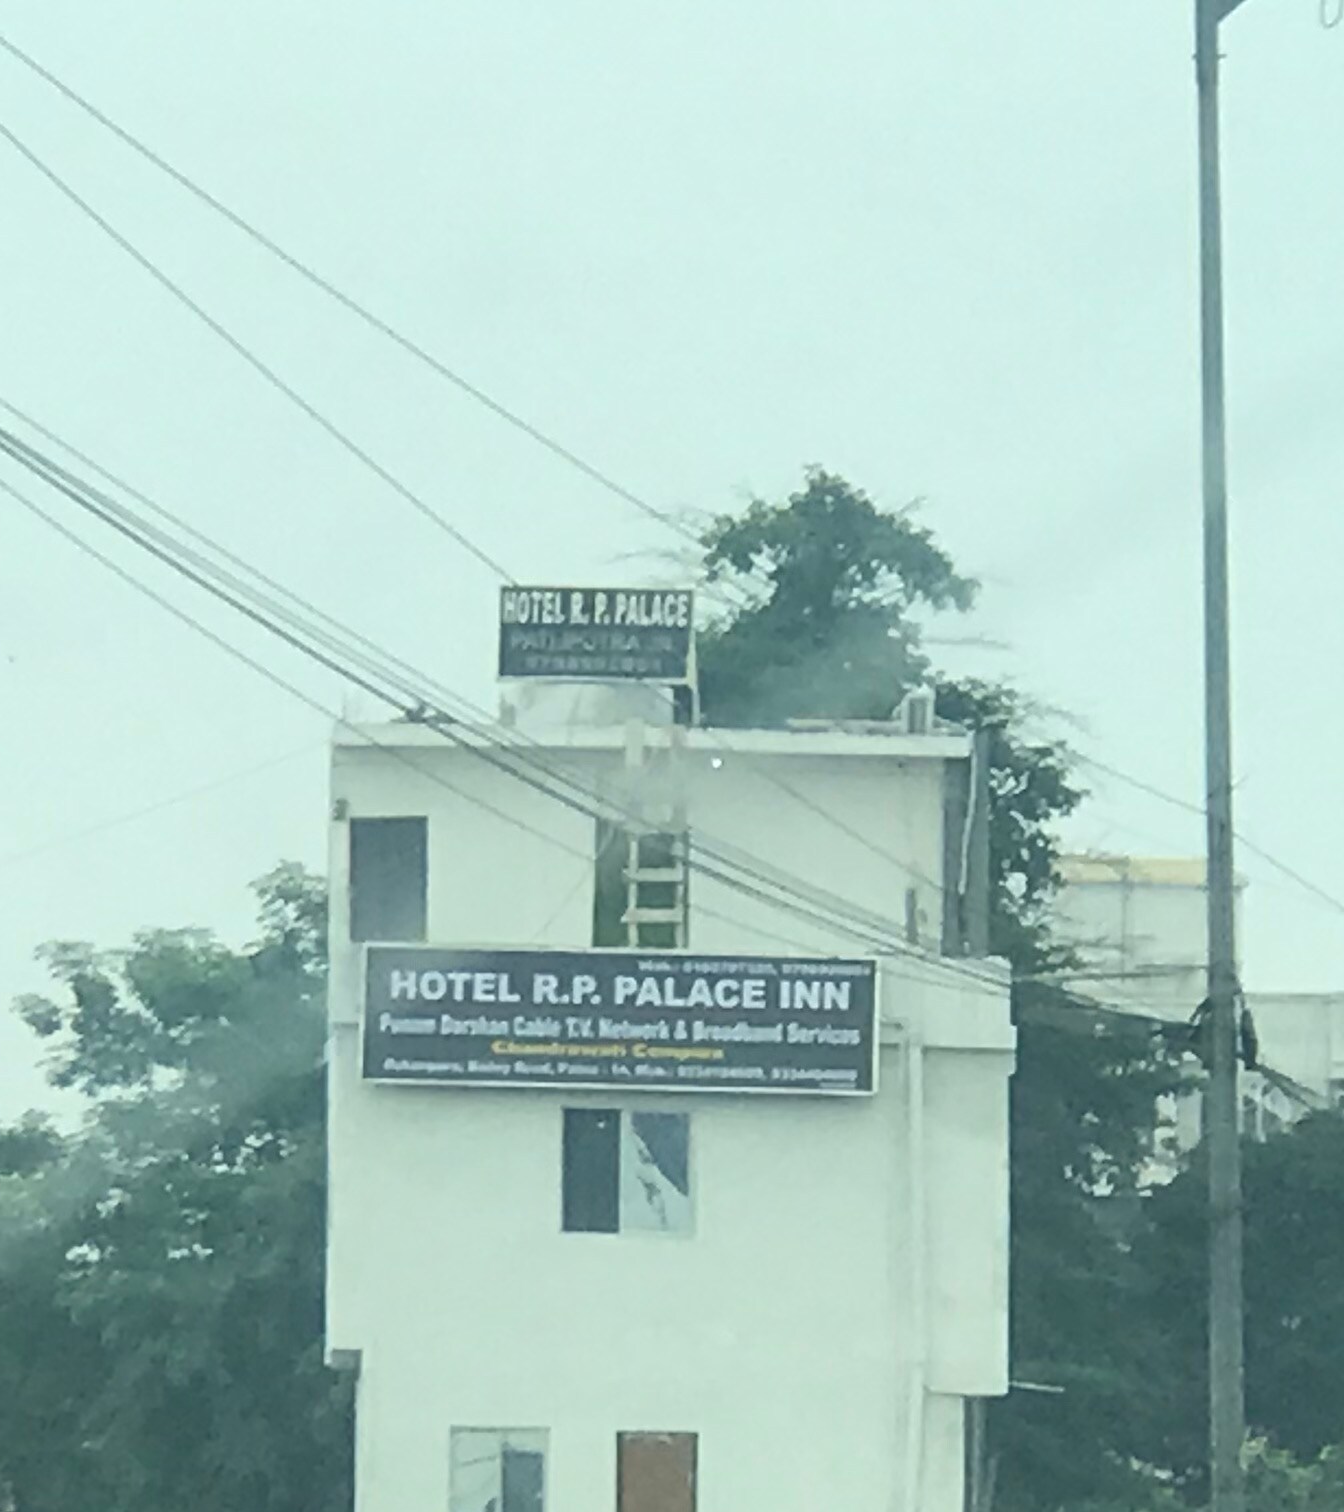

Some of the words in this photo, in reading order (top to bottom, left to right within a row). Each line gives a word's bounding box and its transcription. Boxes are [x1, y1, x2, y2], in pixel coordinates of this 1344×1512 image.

[502, 591, 565, 624] HOTEL
[614, 592, 688, 627] PALACE
[390, 970, 521, 1002] HOTEL
[532, 973, 602, 1005] R.P.
[613, 975, 766, 1008] PALACE
[779, 979, 851, 1011] INN
